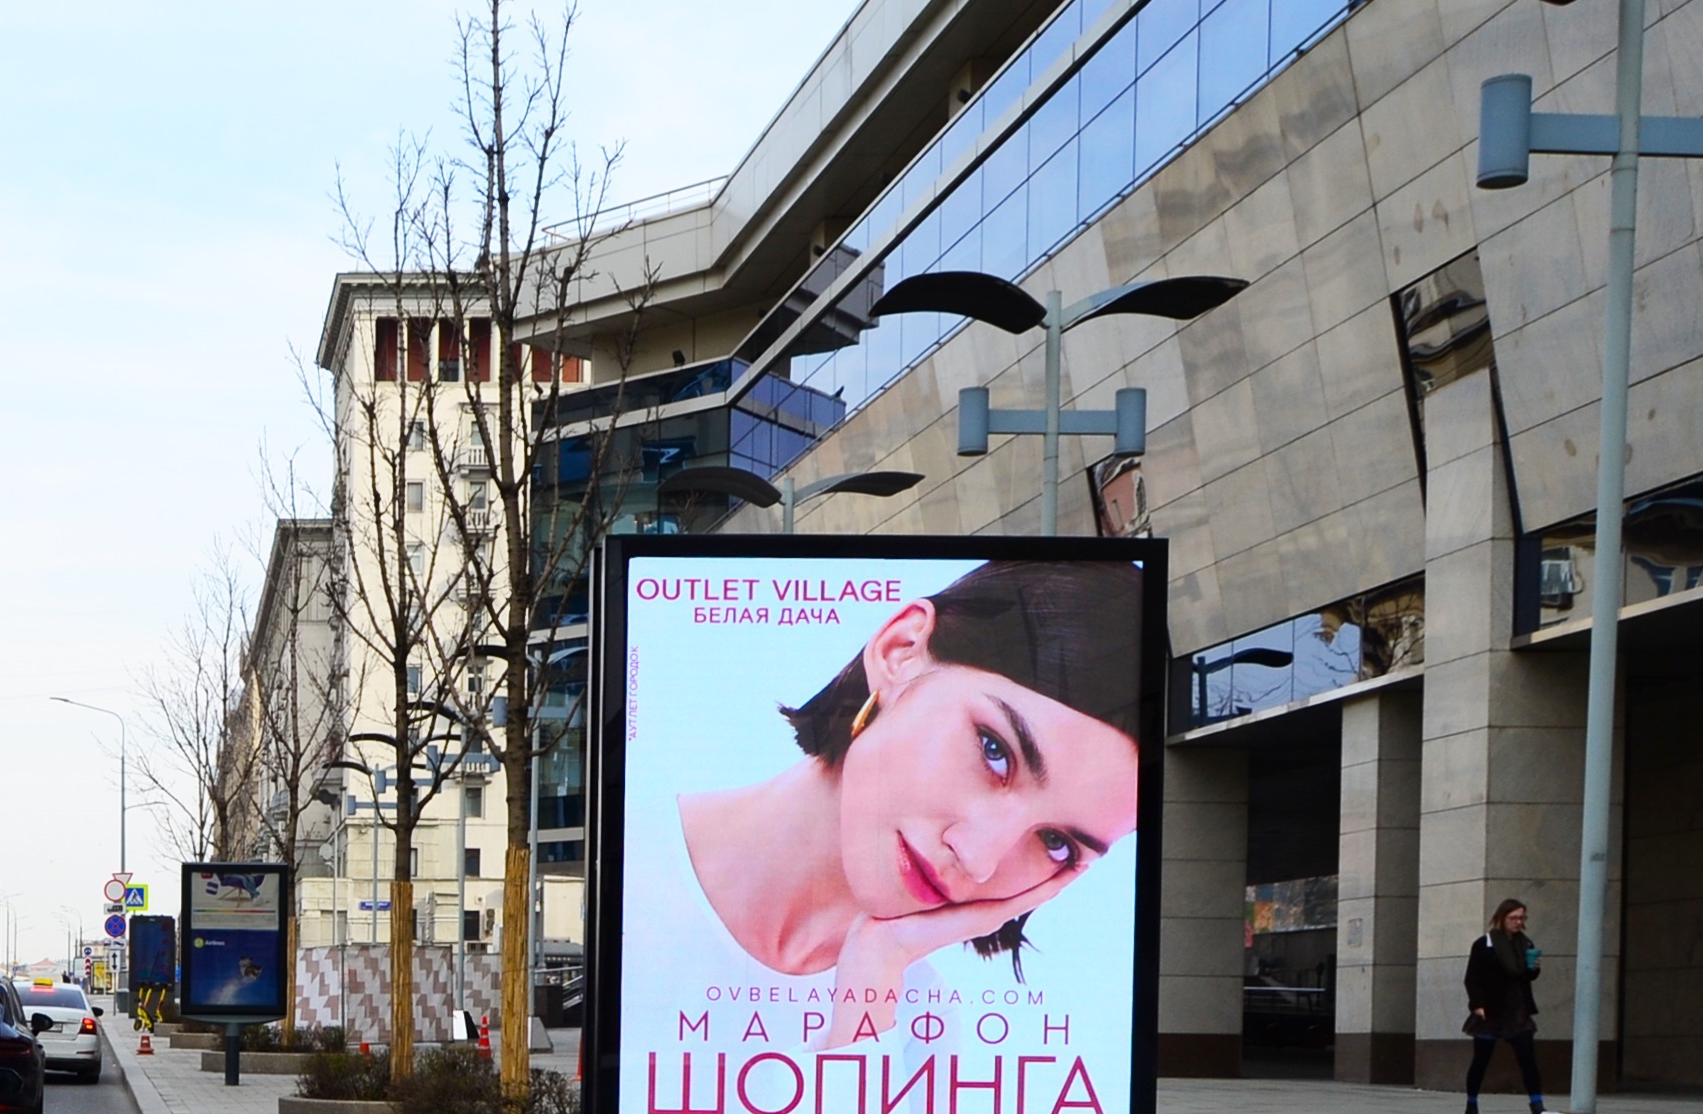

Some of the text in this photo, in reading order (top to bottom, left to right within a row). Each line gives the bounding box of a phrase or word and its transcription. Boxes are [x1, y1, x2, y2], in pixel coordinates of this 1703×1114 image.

[636, 578, 902, 602] OUTLET VILLAGE
[694, 607, 841, 626] БЕЛАЯ ДАЧА
[629, 646, 639, 698] ГОРОДОК
[706, 986, 1044, 1005] OVBELAYADACHA.COM
[679, 1010, 1069, 1045] МАРАФОН
